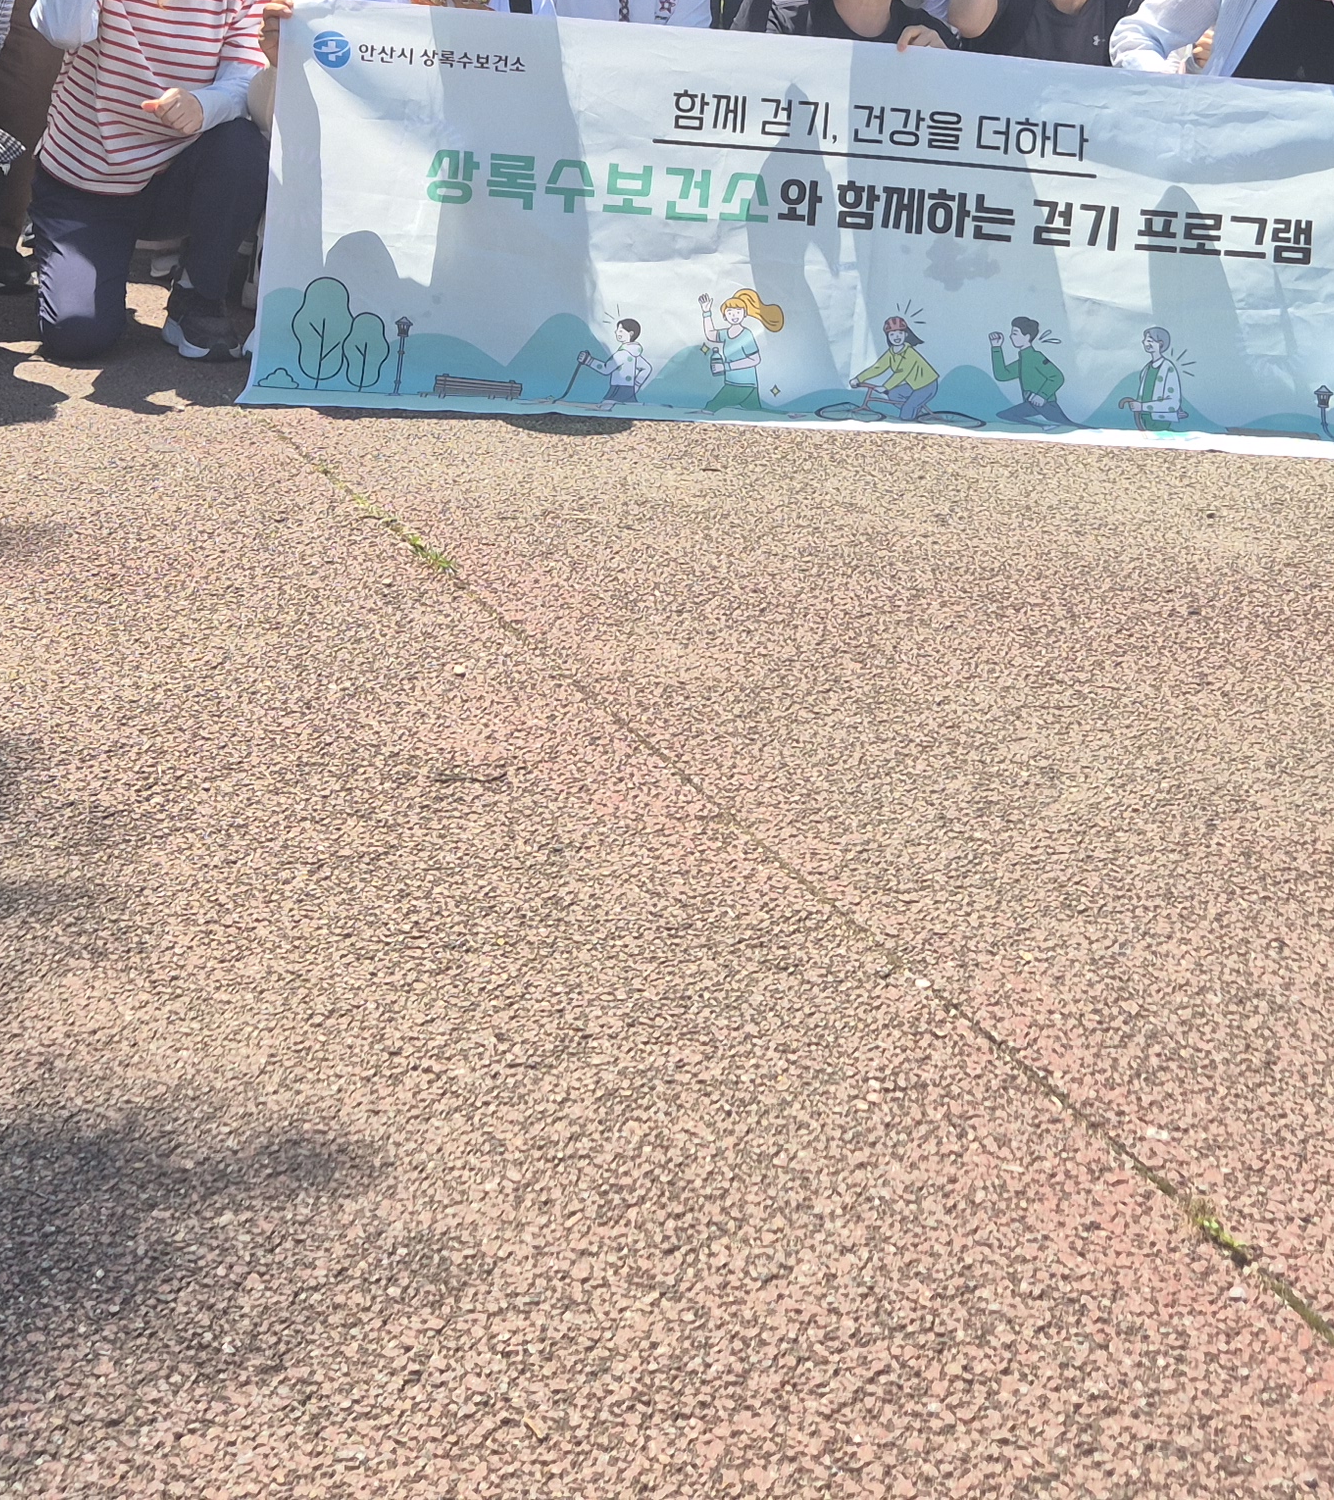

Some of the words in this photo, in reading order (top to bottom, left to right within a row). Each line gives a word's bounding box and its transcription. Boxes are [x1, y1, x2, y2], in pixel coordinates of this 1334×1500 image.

[357, 43, 415, 65] 안산시
[419, 48, 527, 73] 상록수보건소
[672, 88, 748, 134] 함께
[760, 96, 838, 145] 걷기,
[852, 103, 964, 151] 건강을
[975, 114, 1090, 163] 더하다
[425, 148, 824, 228] 상록수보건소와
[836, 179, 1017, 244] 함께하는
[1031, 198, 1121, 253] 걷기
[1133, 208, 1315, 267] 프로그램
